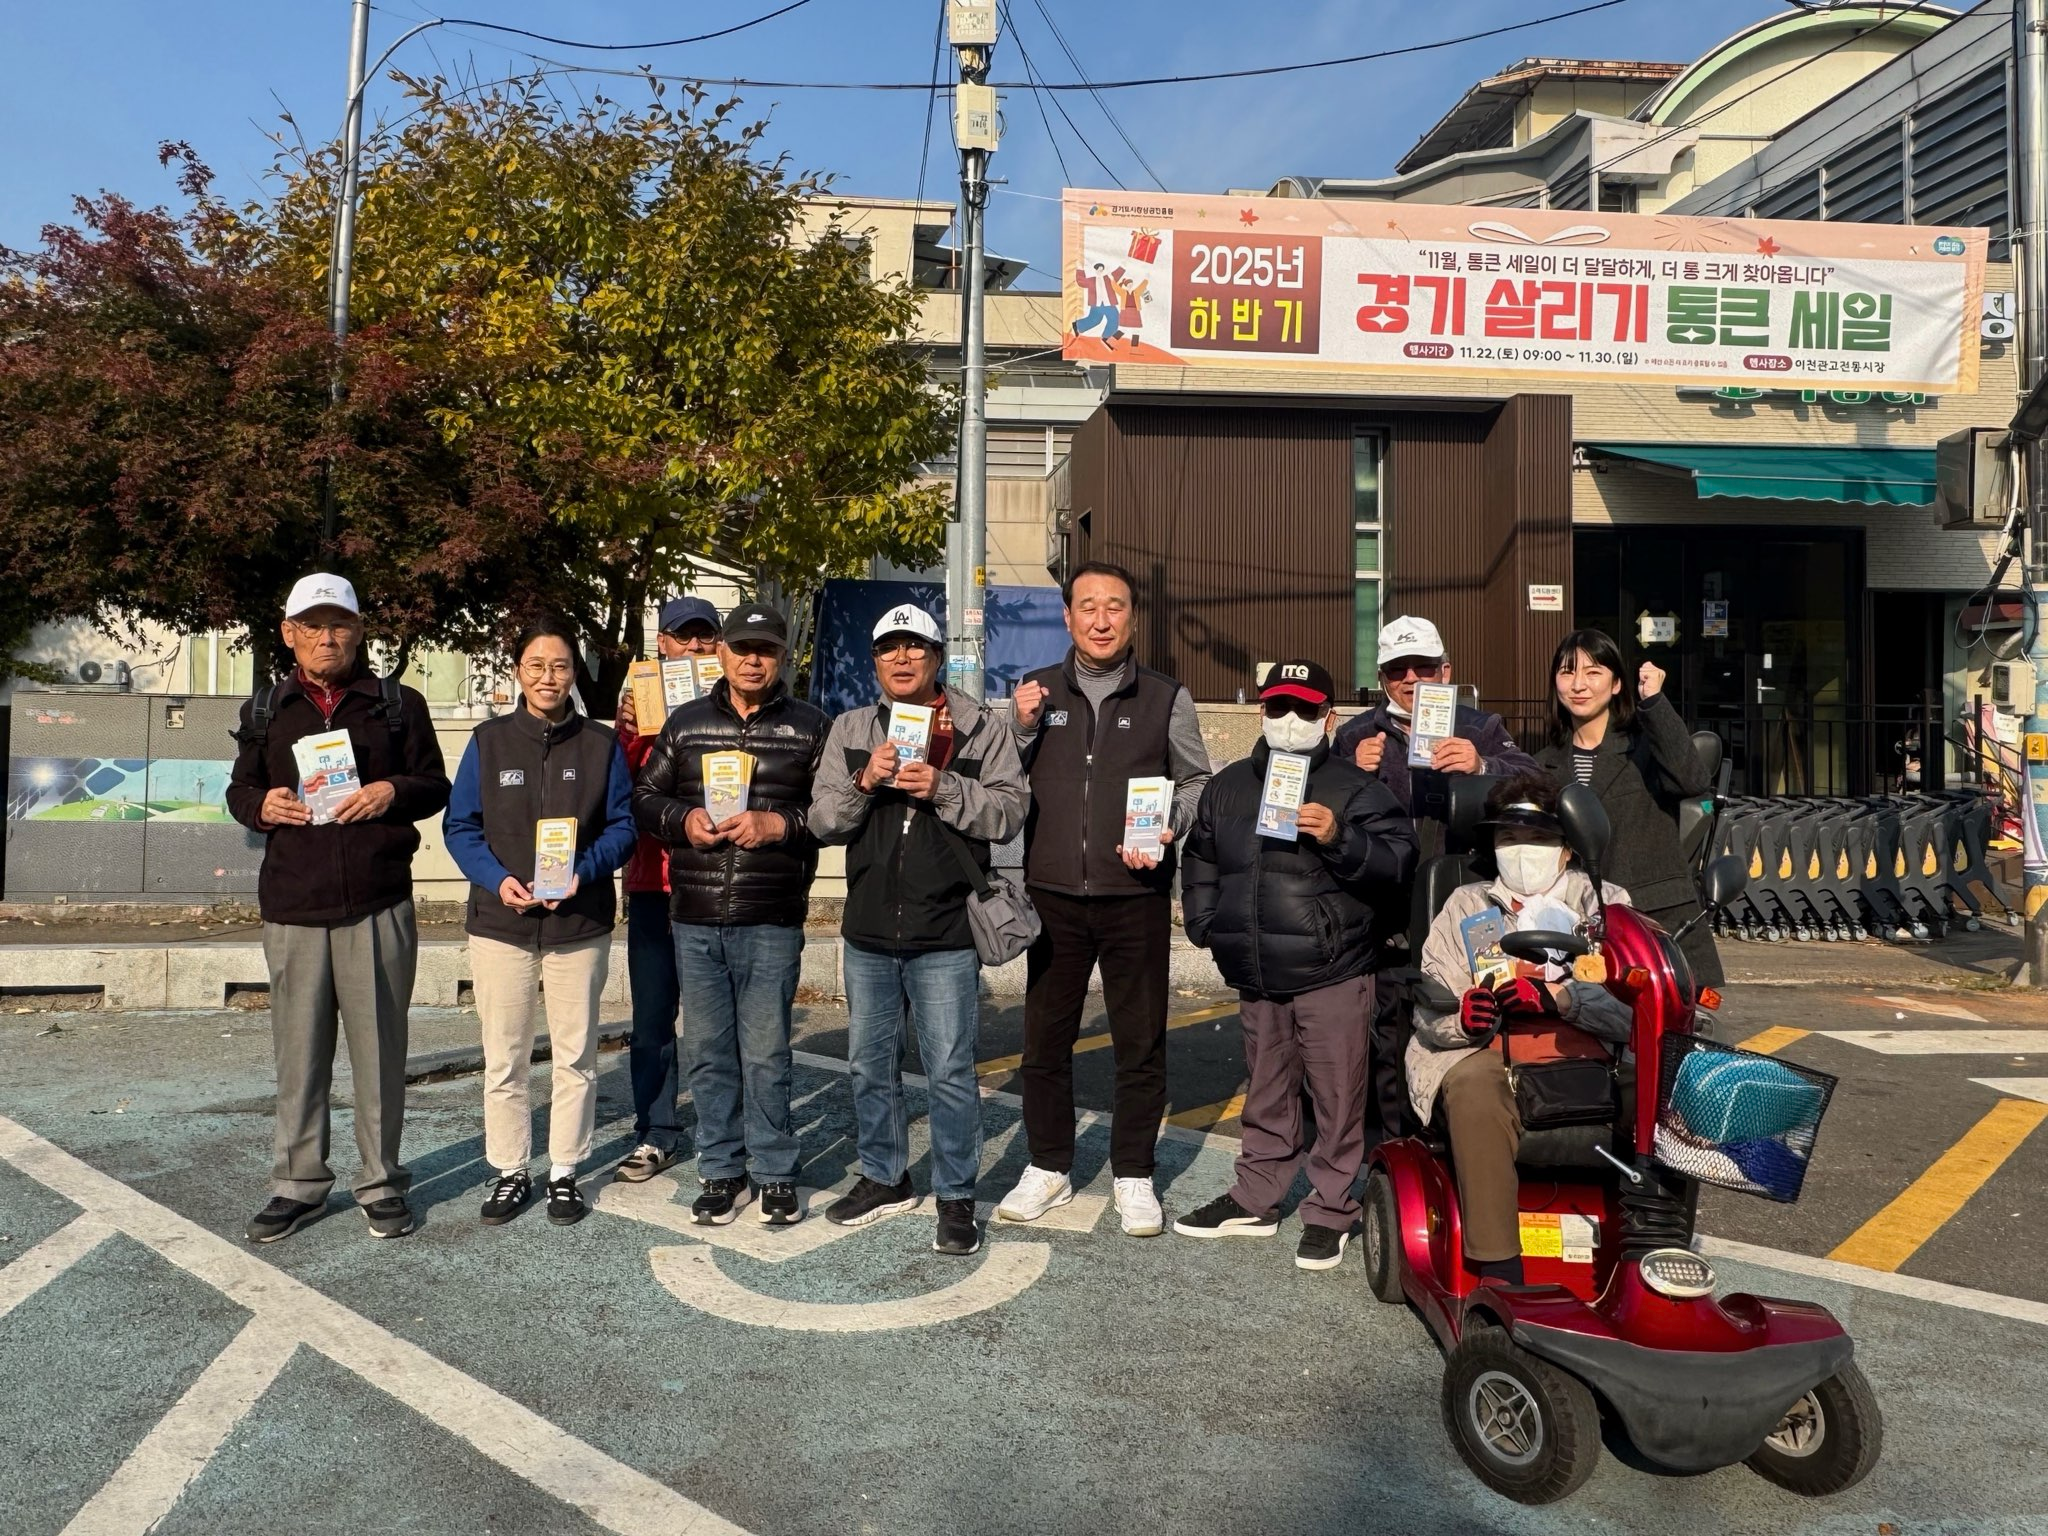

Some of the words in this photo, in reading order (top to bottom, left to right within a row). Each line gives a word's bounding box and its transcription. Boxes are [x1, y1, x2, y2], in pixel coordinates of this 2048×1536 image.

[1190, 244, 1305, 289] 2025년
[1467, 252, 1501, 272] 통큰
[1506, 254, 1557, 275] 세일이
[1563, 256, 1579, 276] 더
[1584, 258, 1656, 281] 달달하게,
[1662, 261, 1678, 280] 더
[1704, 263, 1738, 282] 크게
[1743, 265, 1835, 286] 찾아옵니다”
[1356, 273, 1467, 336] 경기
[1485, 278, 1650, 342] 살리기
[1667, 285, 1771, 347] 통큰
[1788, 290, 1893, 352] 세일
[1460, 346, 1519, 361] 11.22.(토)
[1523, 349, 1562, 362] 09:00
[1579, 352, 1639, 366] 11.30.(일)
[893, 610, 910, 626] LA
[1281, 664, 1309, 680] ITG
